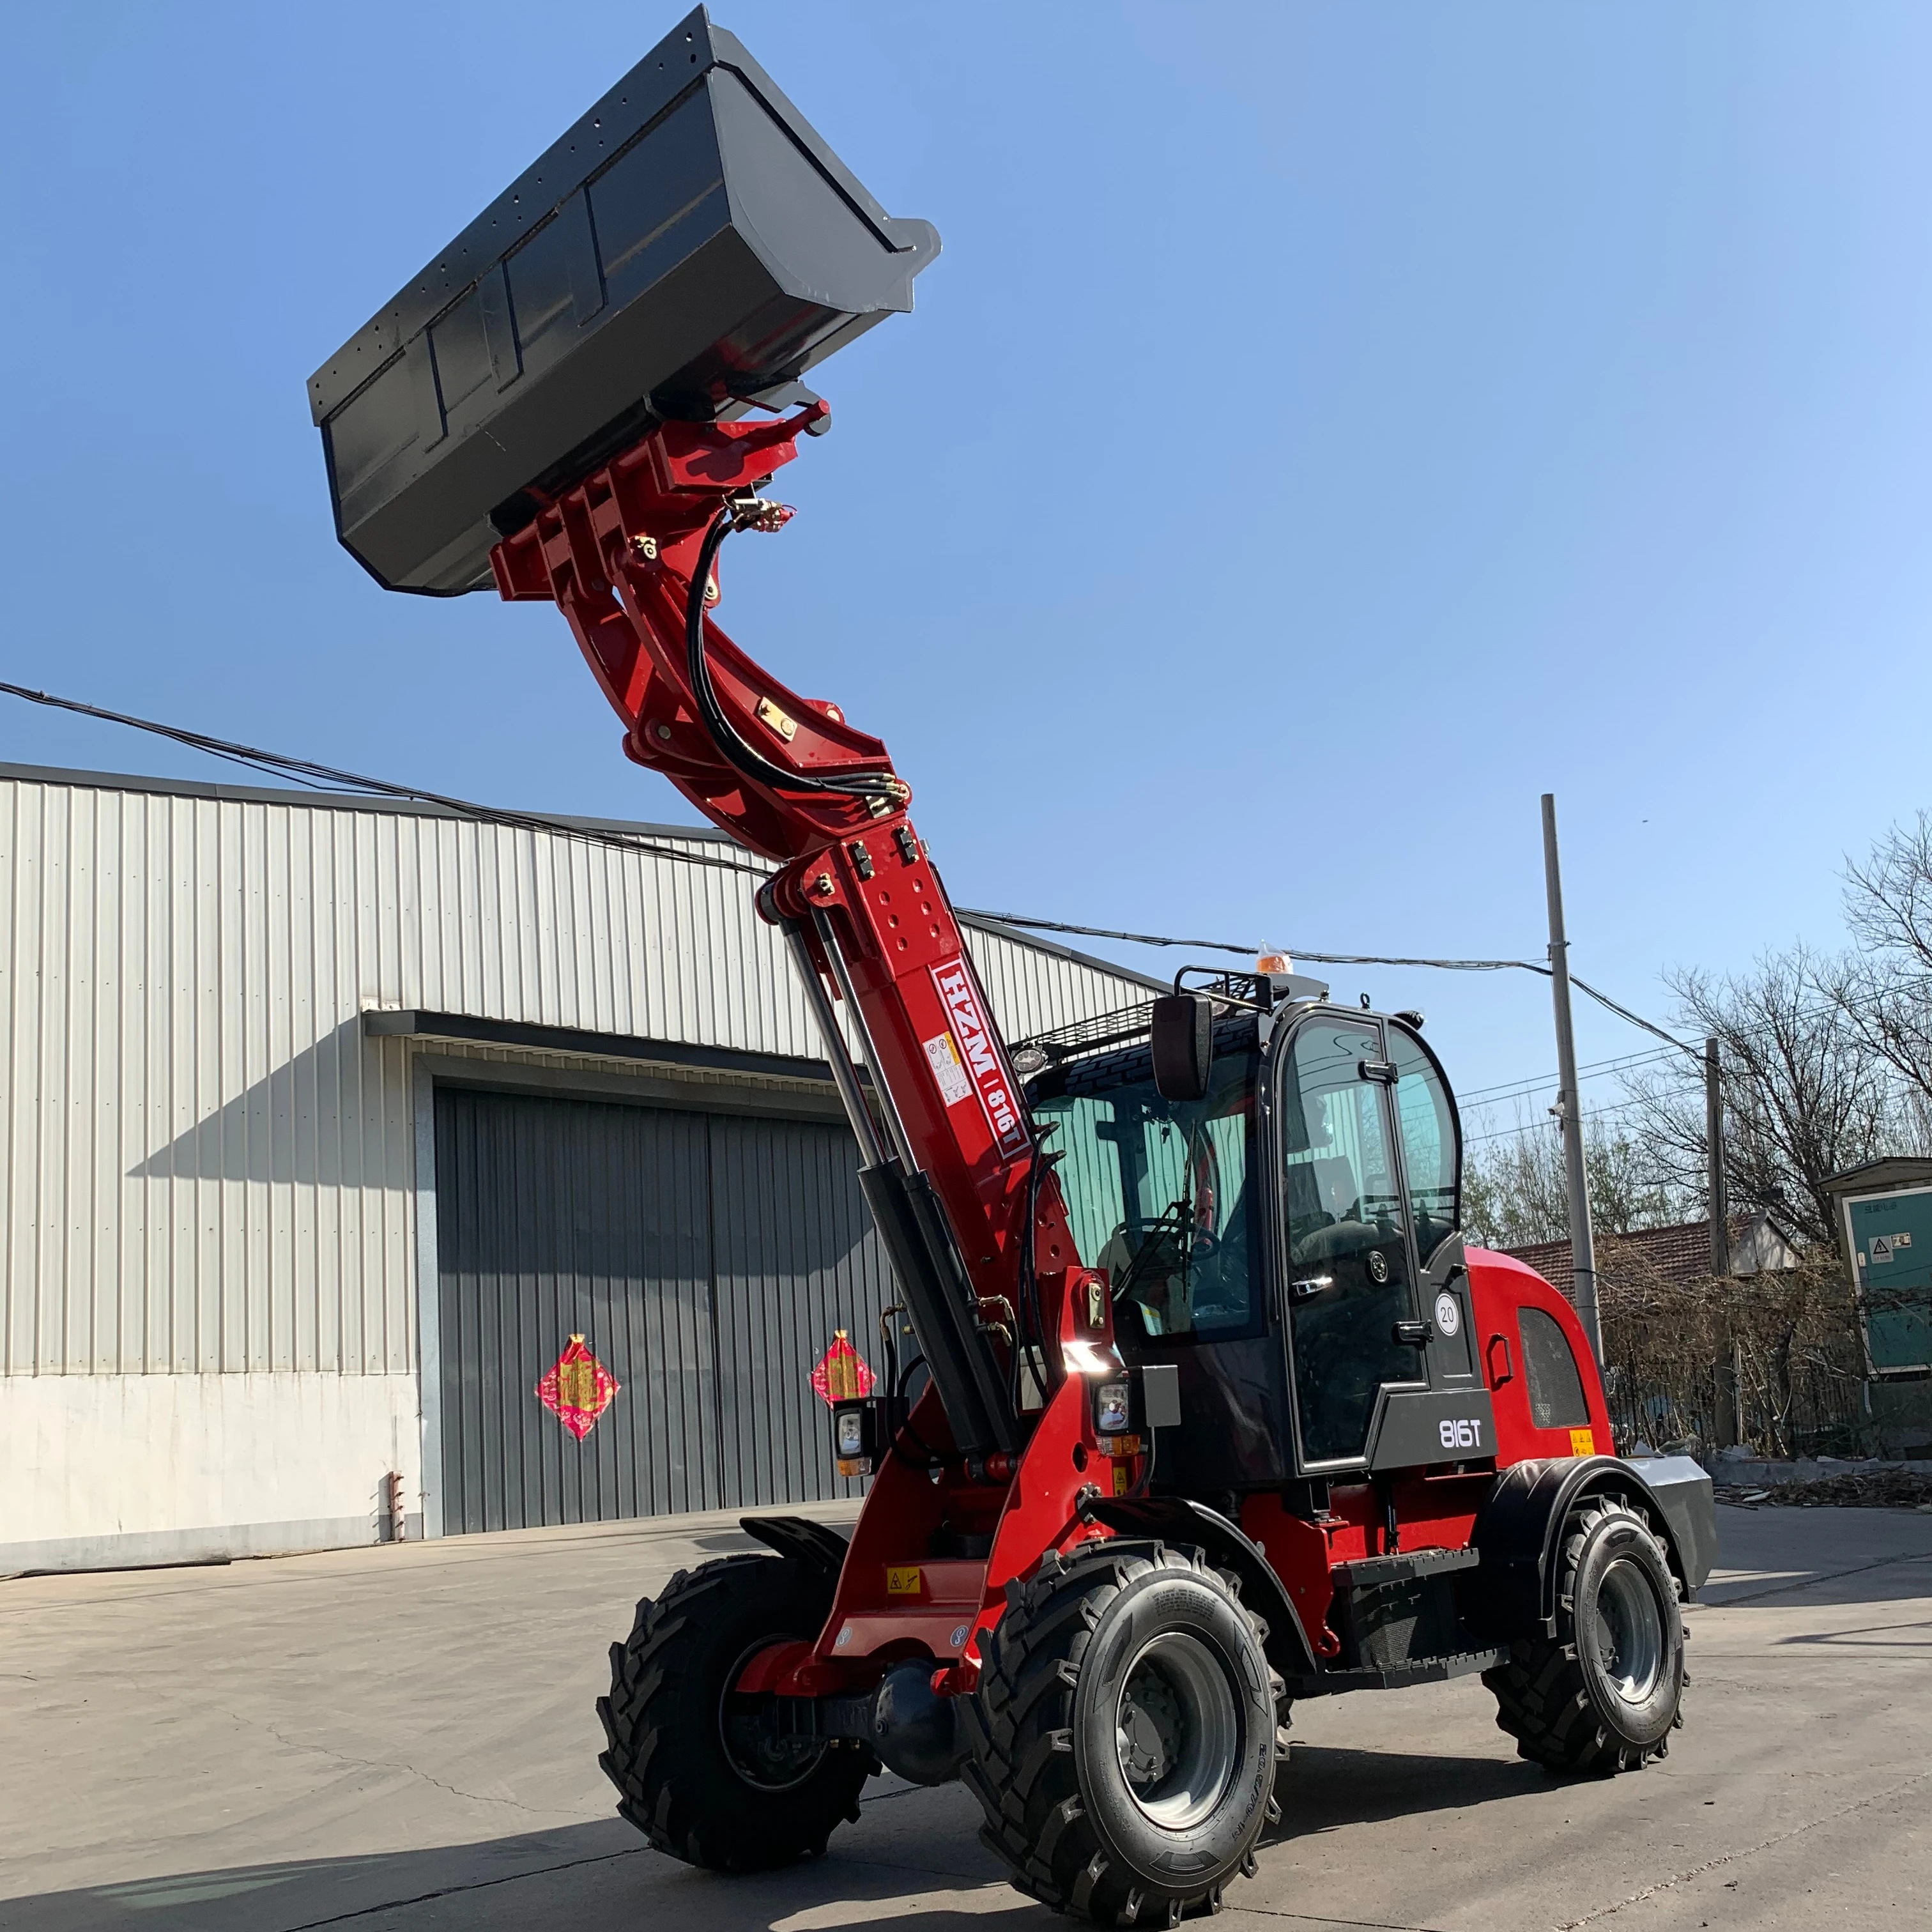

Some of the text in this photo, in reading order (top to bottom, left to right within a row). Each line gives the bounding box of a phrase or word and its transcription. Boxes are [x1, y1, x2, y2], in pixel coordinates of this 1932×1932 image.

[940, 970, 997, 1078] HZM
[987, 1089, 1021, 1146] 816T
[1440, 1307, 1453, 1323] 20
[1439, 1419, 1482, 1448] 816T
